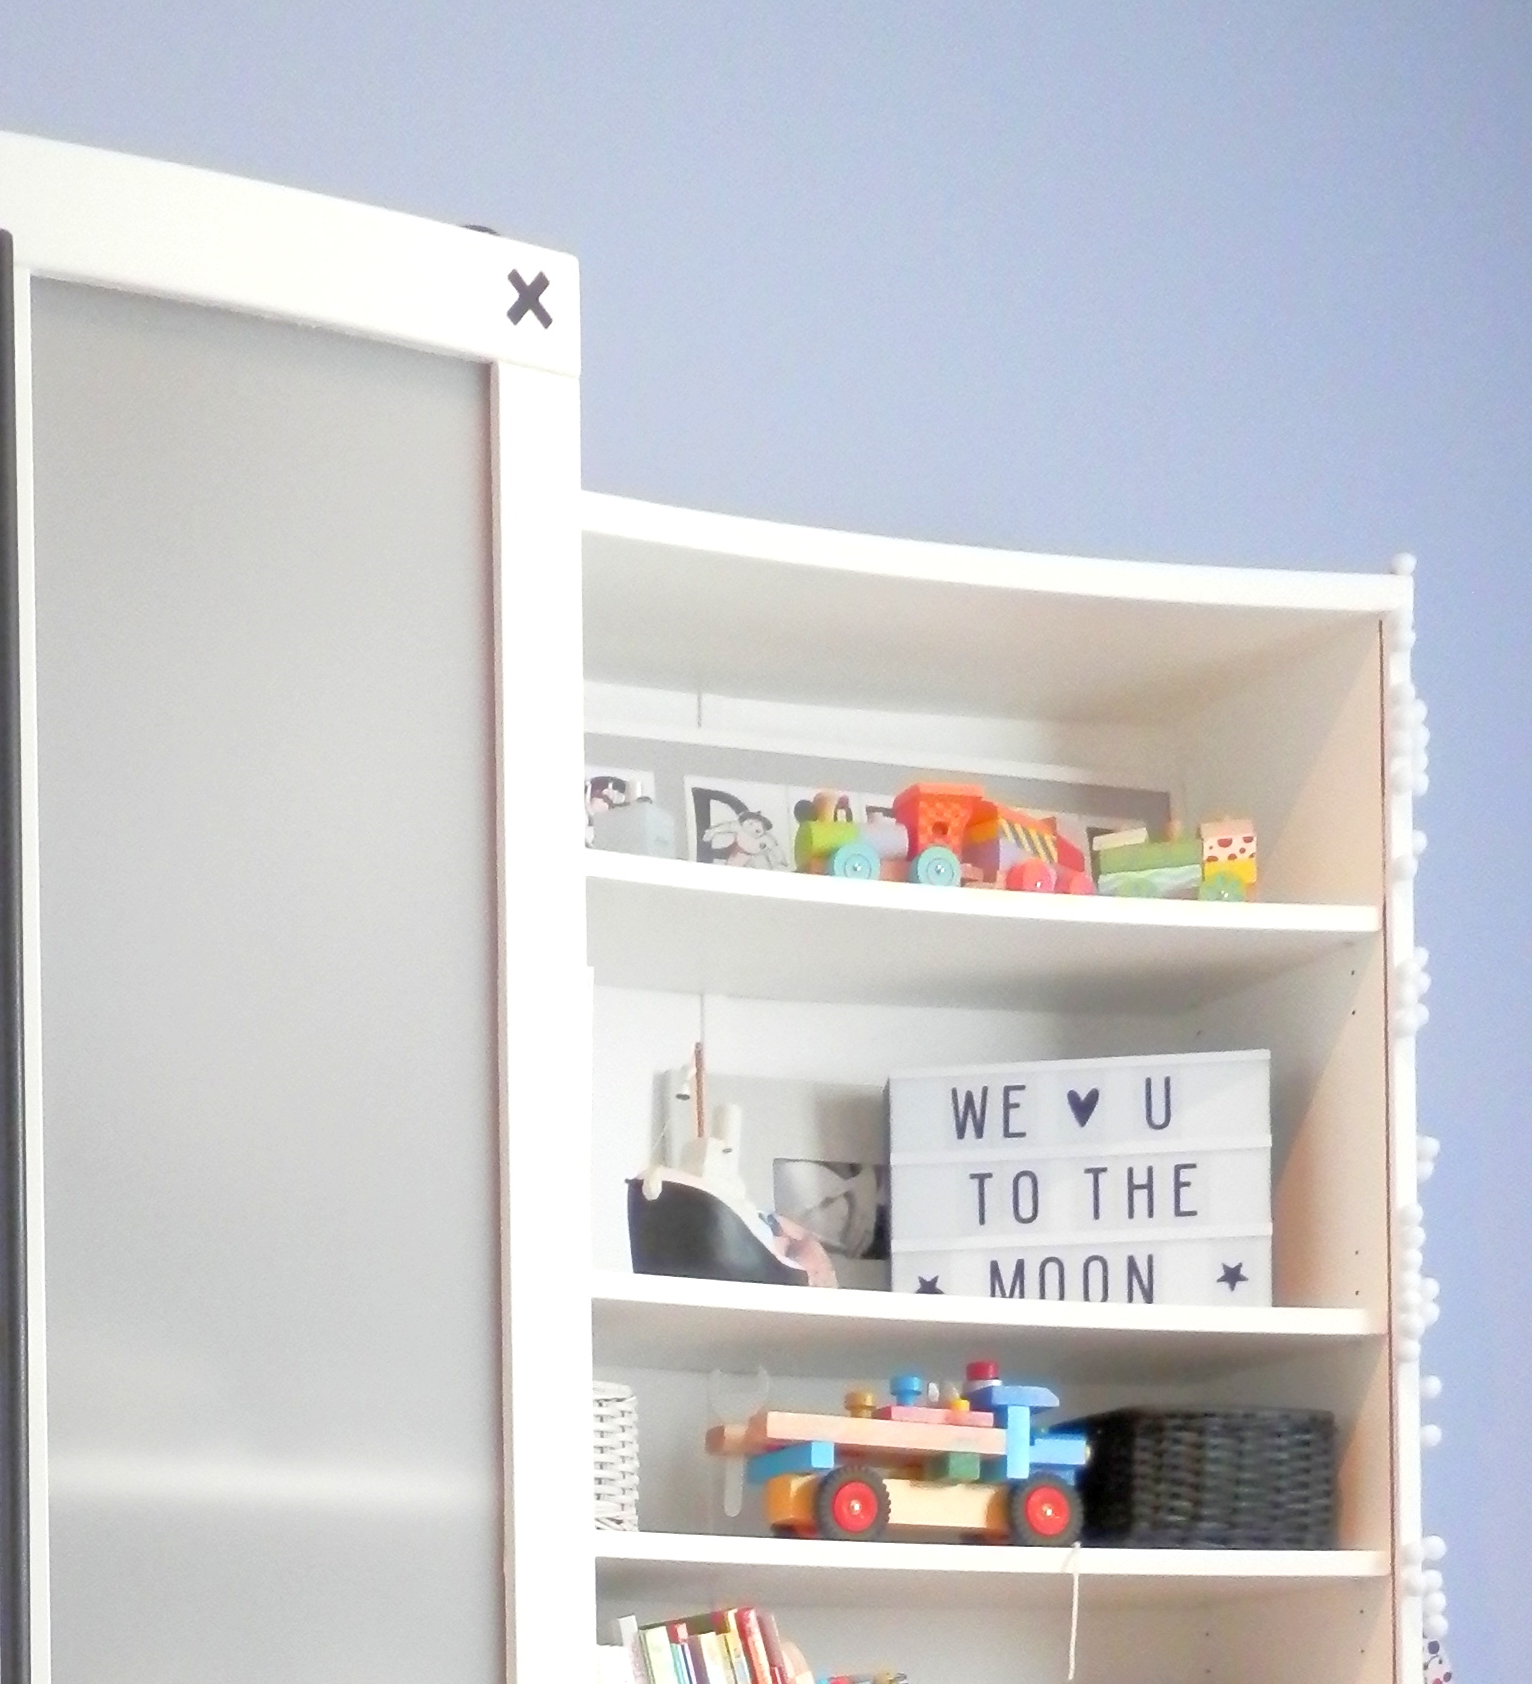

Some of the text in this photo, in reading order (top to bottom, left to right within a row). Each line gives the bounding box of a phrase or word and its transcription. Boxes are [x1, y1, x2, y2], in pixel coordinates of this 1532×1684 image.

[951, 1075, 1172, 1140] WE U
[969, 1162, 1199, 1226] TO THE
[989, 1253, 1155, 1305] MOON
